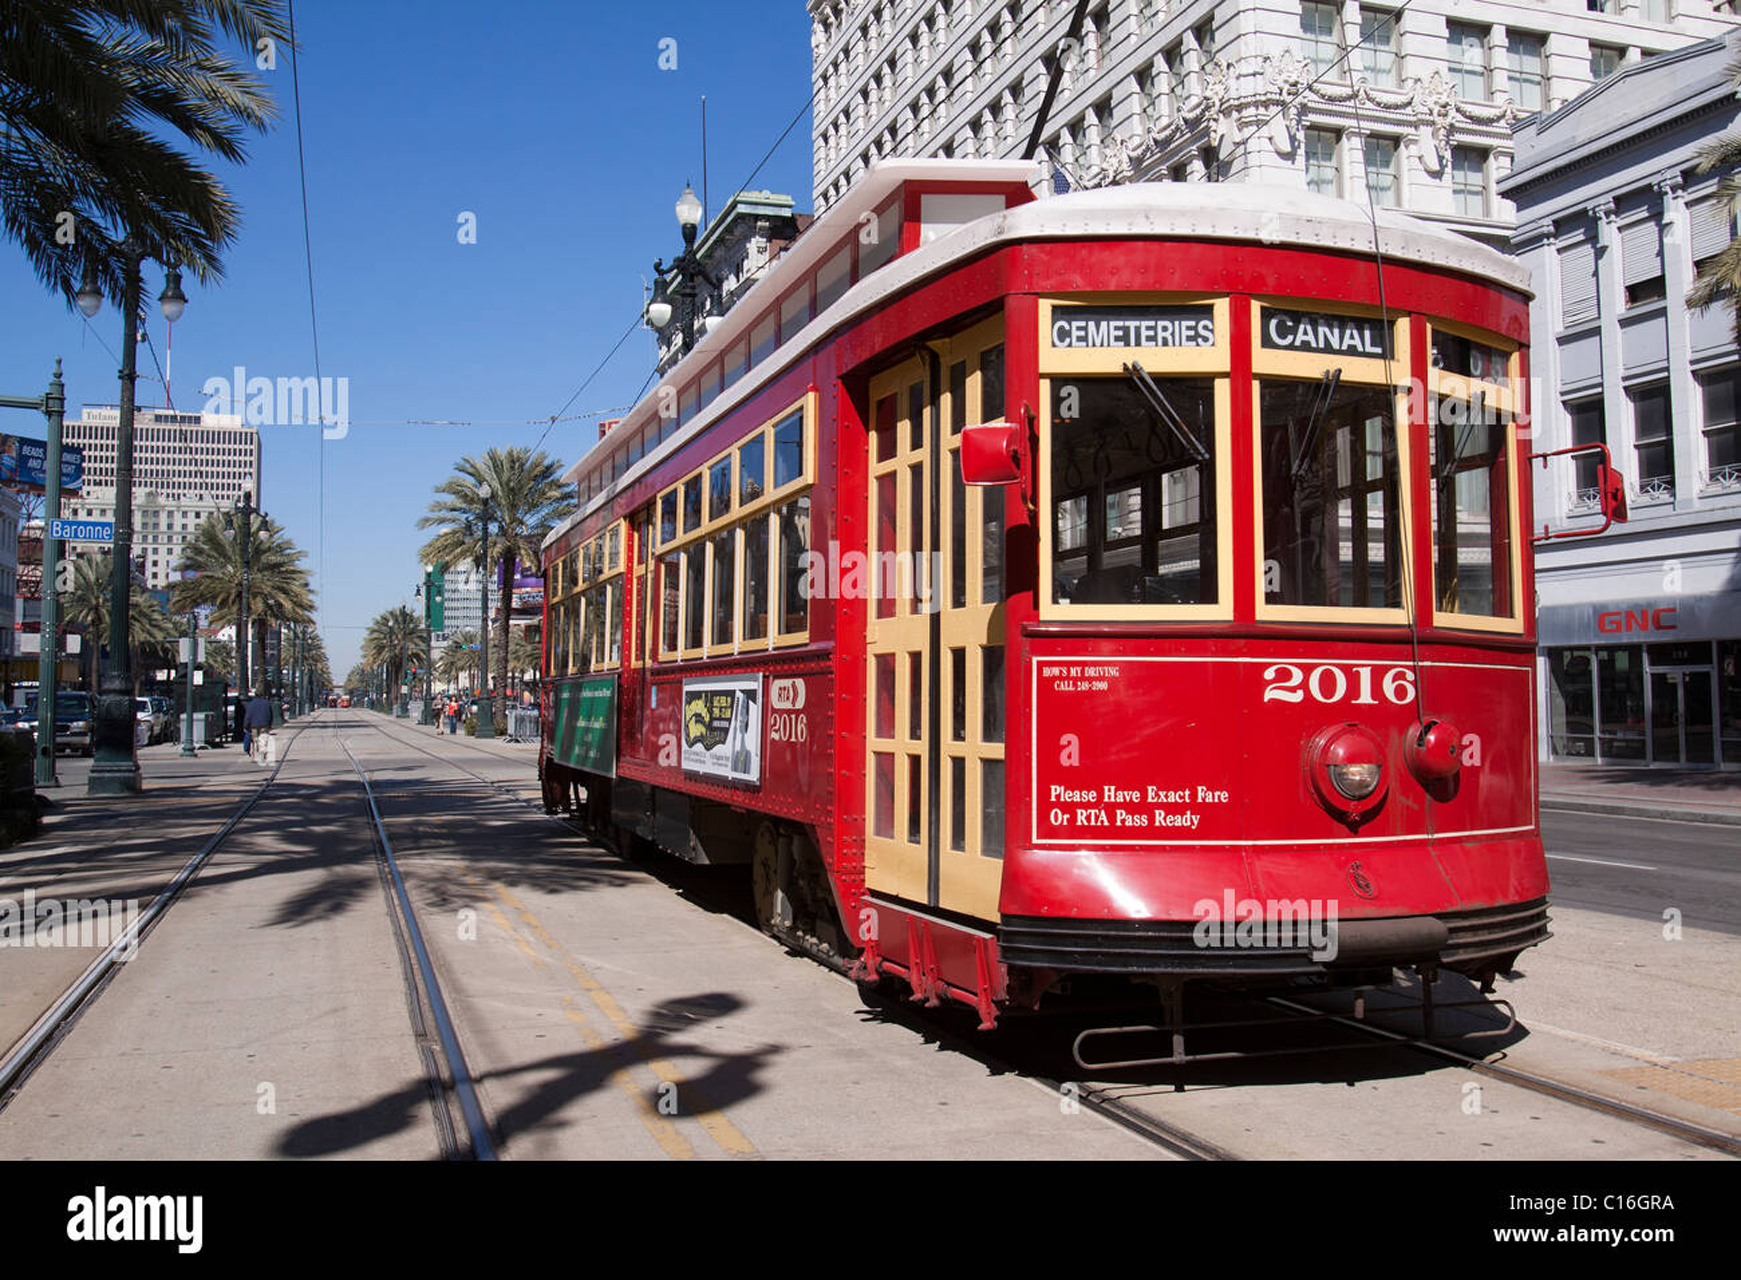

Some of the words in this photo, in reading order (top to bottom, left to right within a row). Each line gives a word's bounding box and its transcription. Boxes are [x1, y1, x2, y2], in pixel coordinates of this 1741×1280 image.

[1052, 320, 1214, 348] CEMETERIES
[1269, 315, 1383, 355] CANAL
[86, 412, 119, 421] Tulane
[53, 521, 111, 539] Baronne
[1597, 607, 1678, 633] GNC
[1042, 666, 1067, 677] HOW'S
[1069, 666, 1082, 677] MY
[1084, 666, 1119, 677] DRIVING
[1054, 680, 1075, 691] CALL
[1263, 664, 1415, 705] 2016
[778, 686, 790, 703] RTA
[771, 713, 807, 742] 2016
[1050, 785, 1097, 802] Please
[1103, 785, 1141, 803] Have
[1146, 785, 1191, 803] Exact
[1197, 786, 1229, 803] Fare
[1050, 808, 1070, 826] Or
[1076, 809, 1109, 826] RTA
[1115, 809, 1148, 826] Pass
[1154, 809, 1200, 829] Ready
